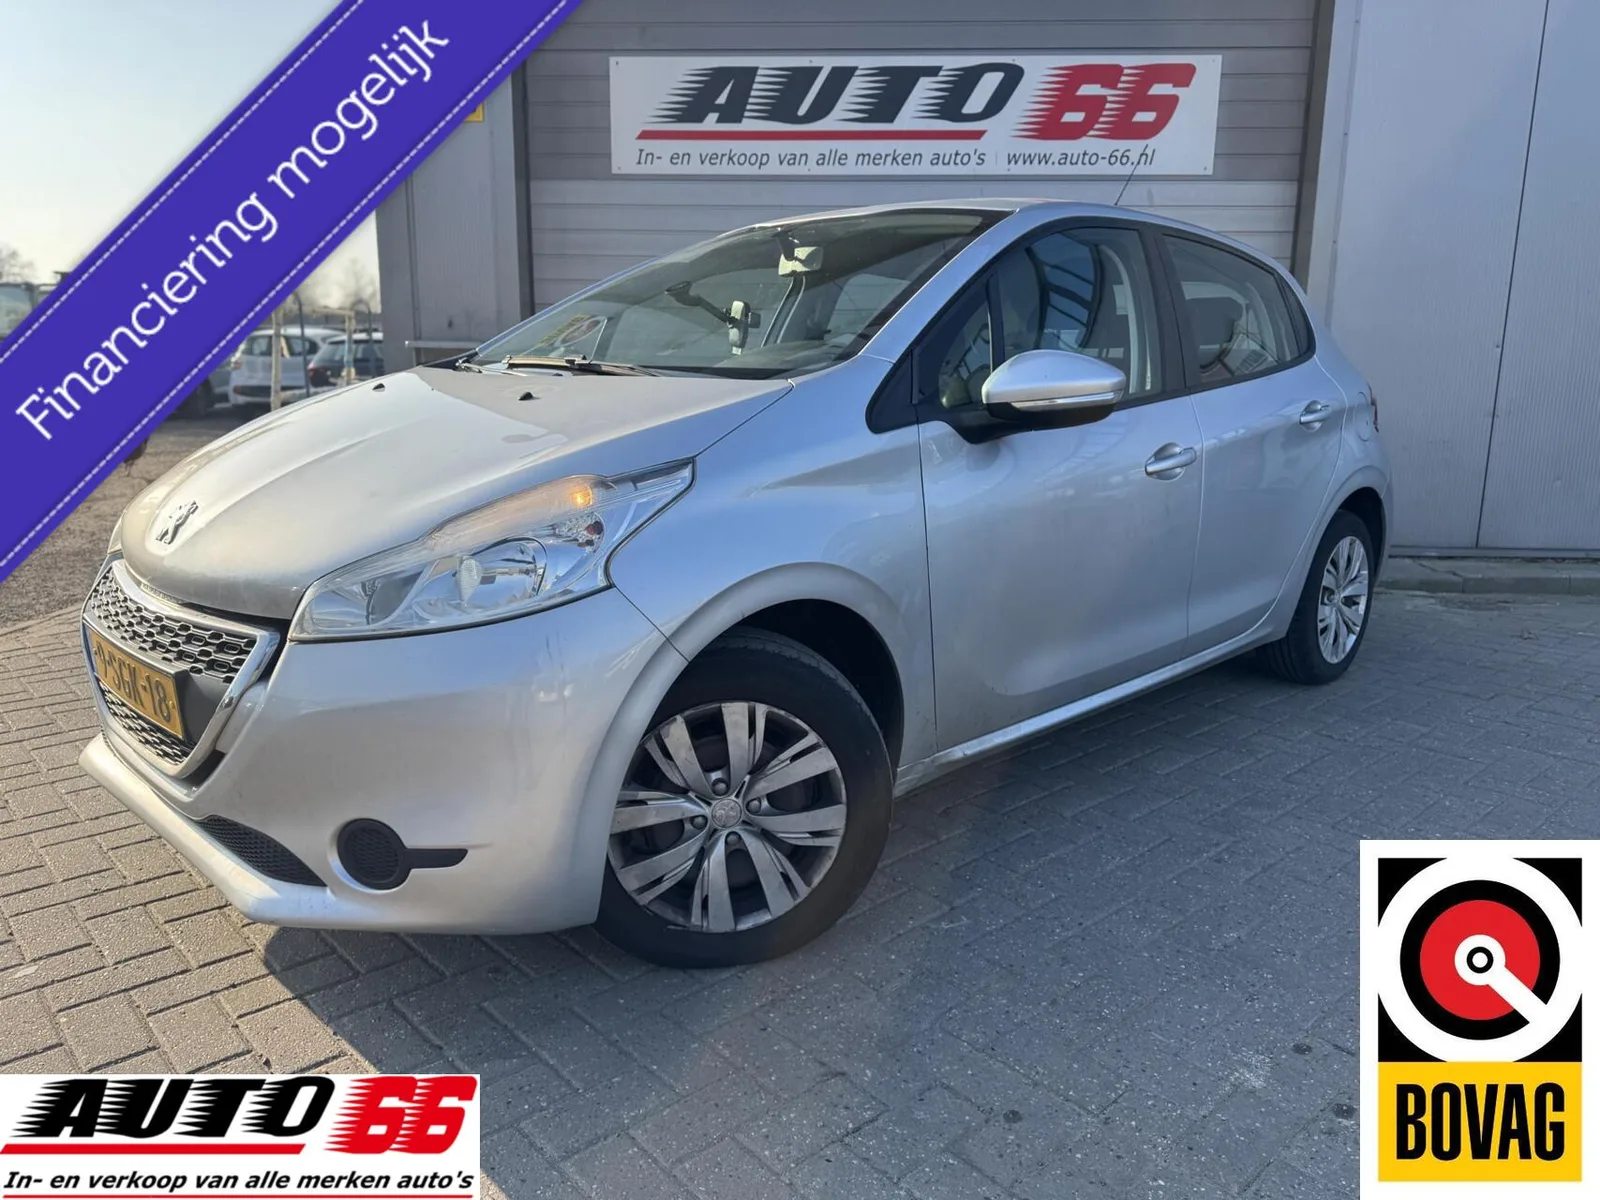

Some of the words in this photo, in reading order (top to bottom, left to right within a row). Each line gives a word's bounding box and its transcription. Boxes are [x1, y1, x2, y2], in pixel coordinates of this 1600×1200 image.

[643, 62, 1025, 126] AUTO
[1009, 62, 1197, 141] 66
[636, 148, 662, 165] In-
[669, 152, 691, 166] en
[699, 149, 770, 170] verkoop
[778, 152, 809, 166] van
[815, 149, 848, 166] alle
[855, 149, 923, 166] merken
[929, 148, 986, 166] auto's
[1007, 148, 1156, 166] www.auto-66.nl
